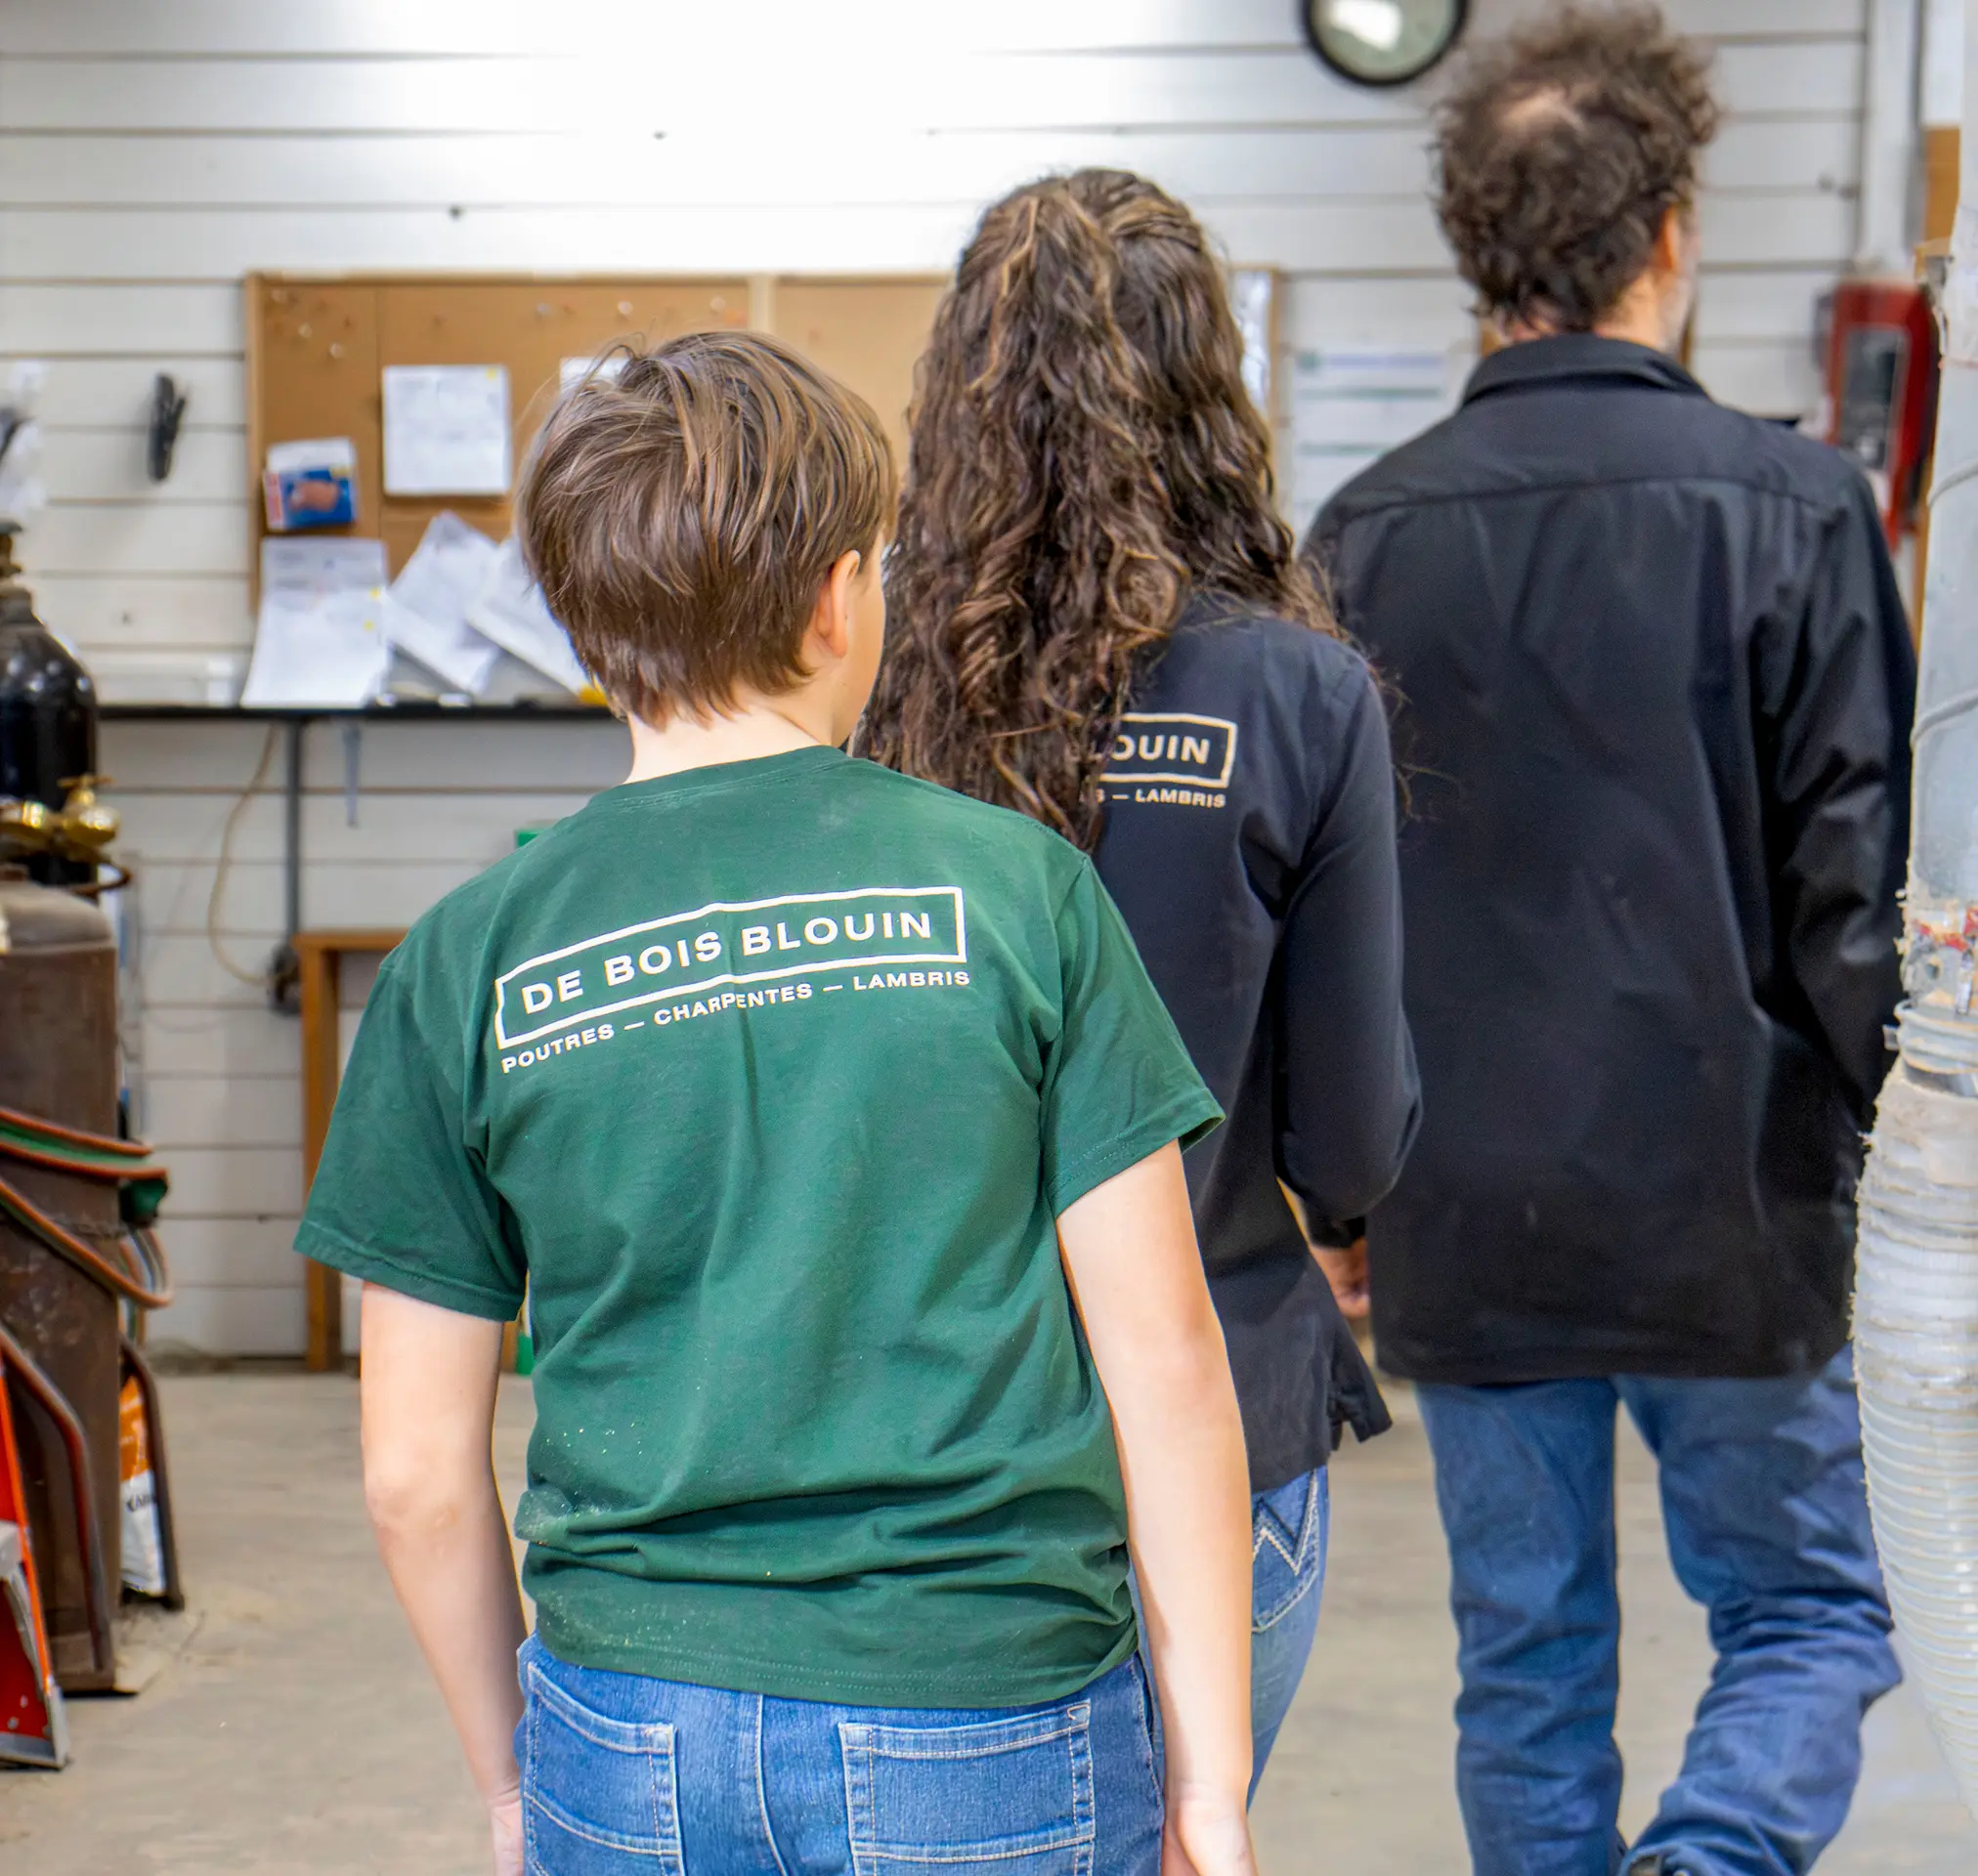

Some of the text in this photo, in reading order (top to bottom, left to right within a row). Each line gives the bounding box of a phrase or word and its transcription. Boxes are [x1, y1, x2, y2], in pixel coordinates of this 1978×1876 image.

[1110, 735, 1210, 764] OUIN
[1135, 789, 1226, 807] LAMBRIS
[522, 912, 931, 1014] DE BOIS BLOUIN
[501, 1023, 615, 1073] POUTRES
[654, 983, 813, 1026] CHARPENTES
[853, 970, 970, 991] LAMBRIS
